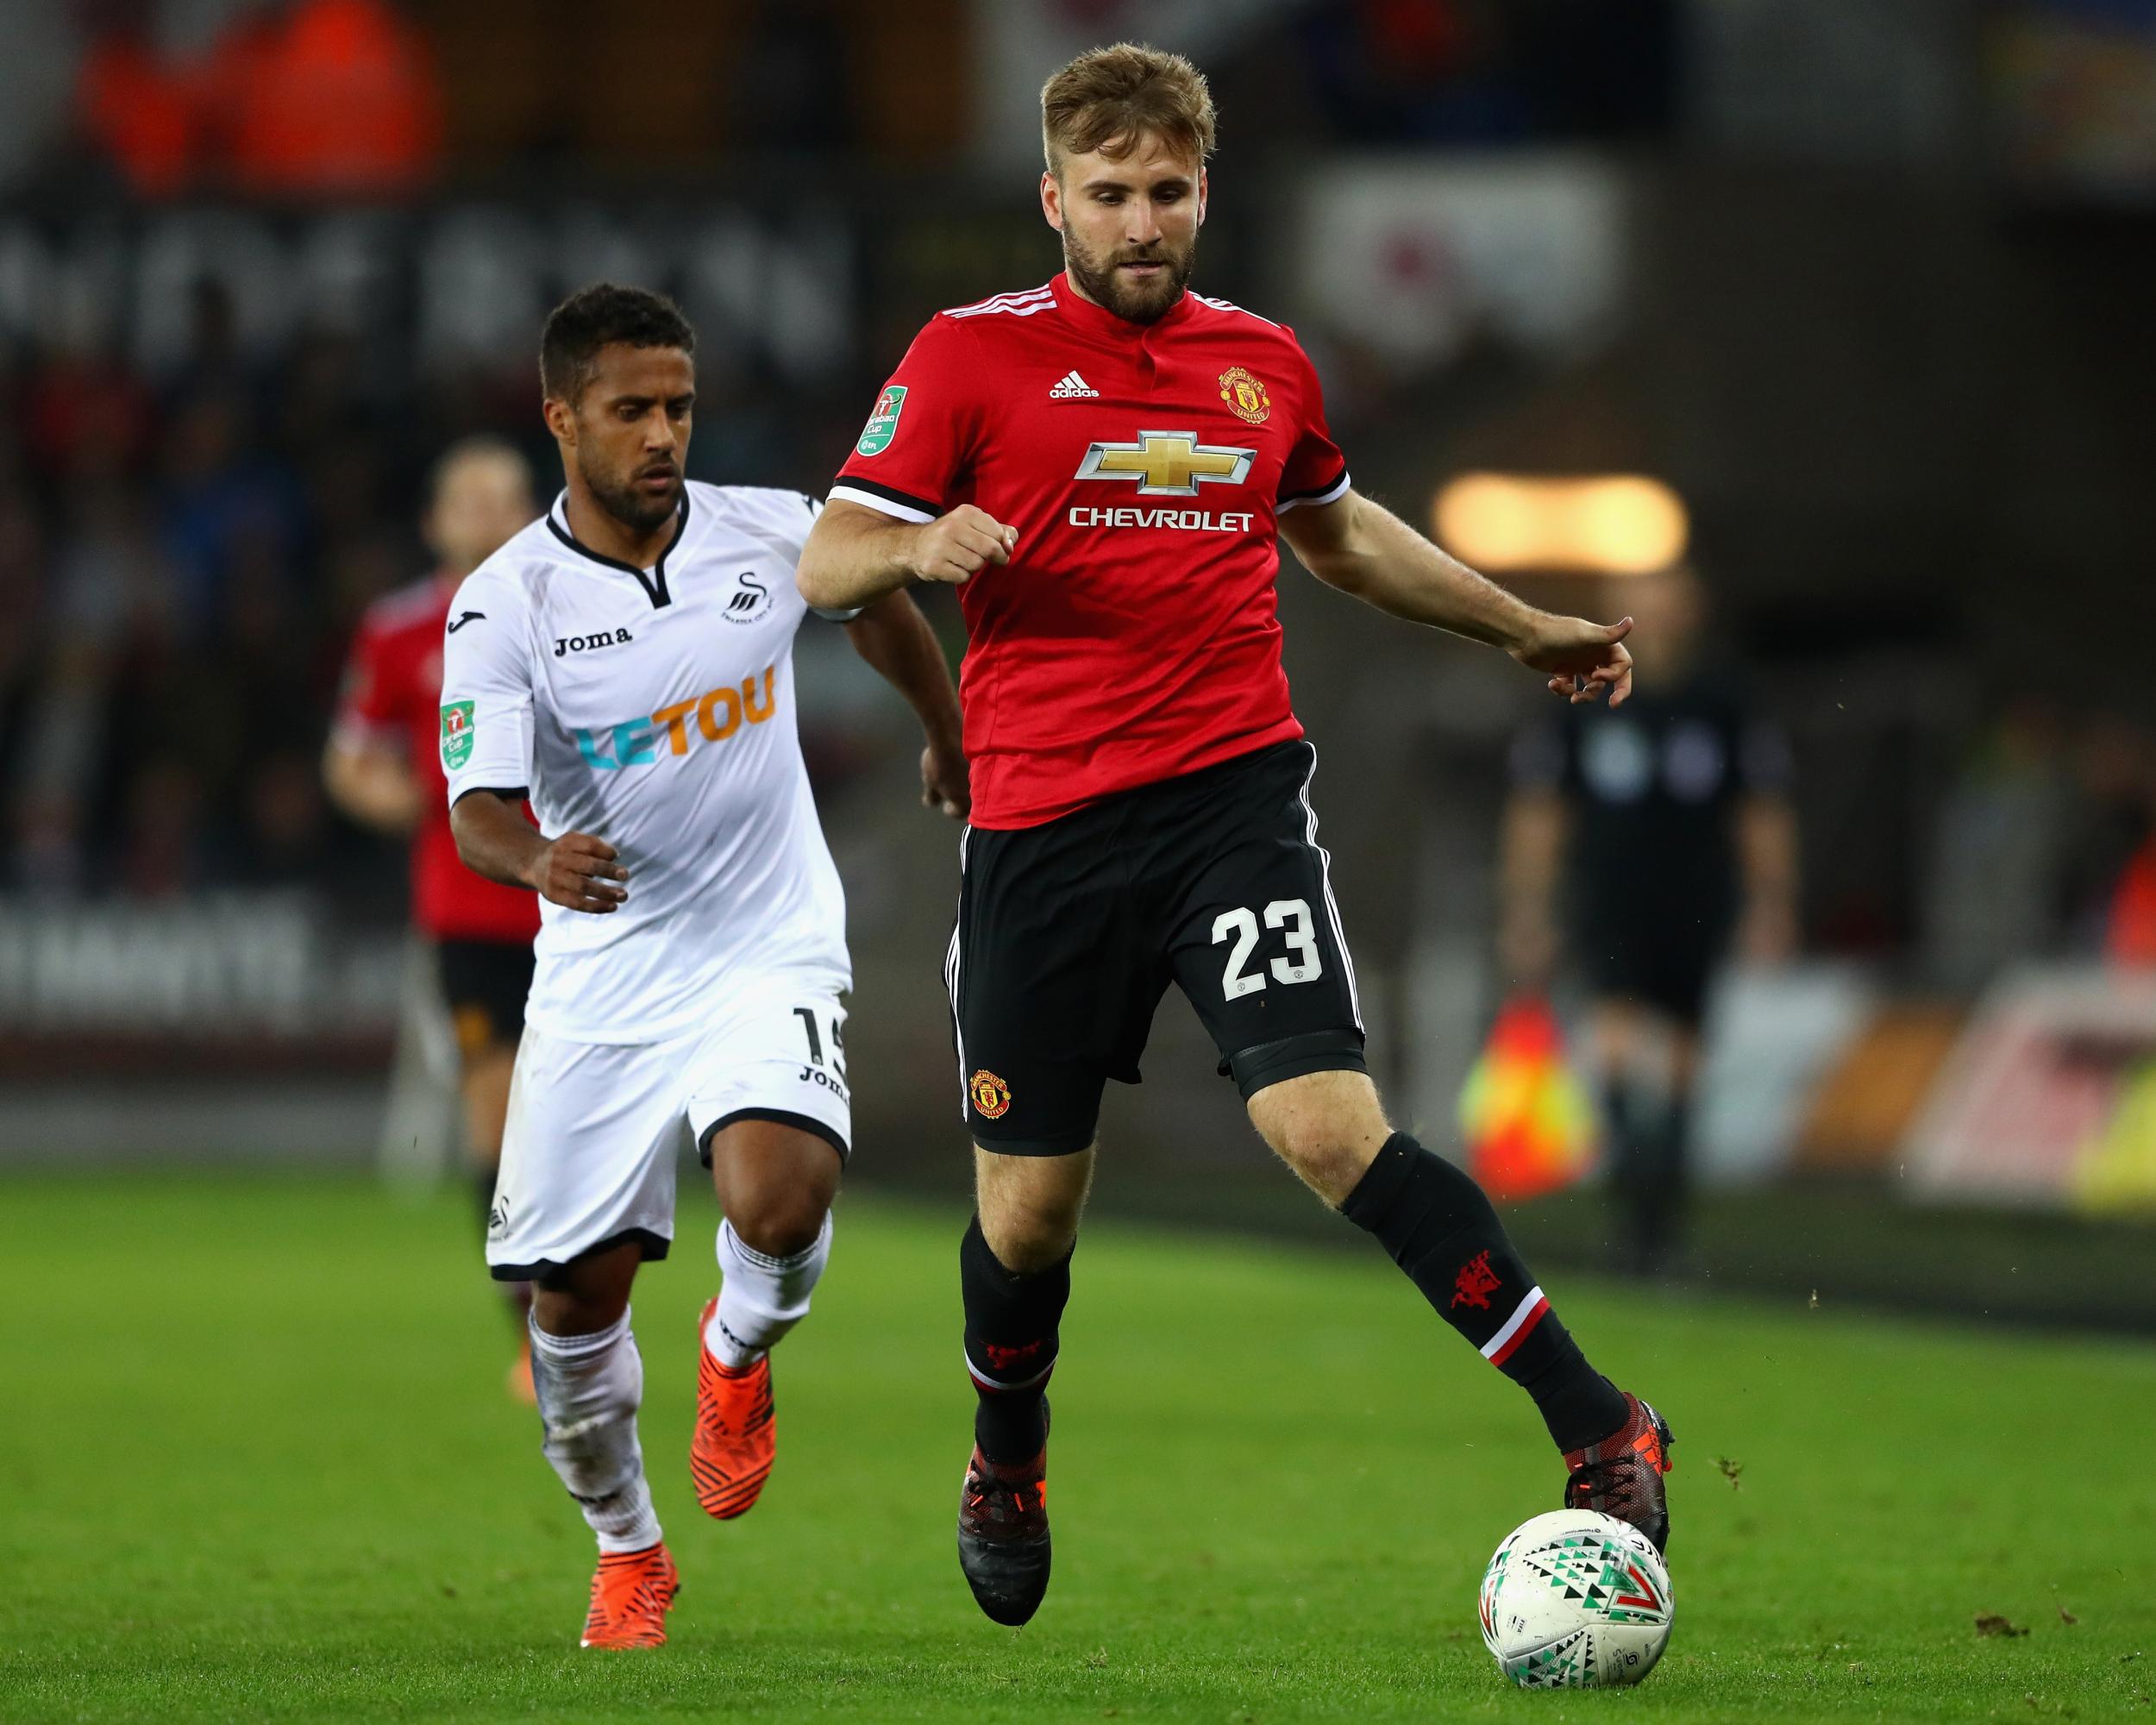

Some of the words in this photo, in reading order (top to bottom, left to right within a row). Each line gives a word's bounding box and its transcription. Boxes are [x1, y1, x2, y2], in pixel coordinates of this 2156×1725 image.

[1049, 387, 1100, 398] adidas
[1237, 408, 1266, 420] UNITED
[868, 425, 882, 434] Cup
[1069, 506, 1255, 532] CHEVROLET
[555, 628, 634, 657] Joma
[575, 662, 776, 770] LETOU
[1211, 898, 1323, 1002] 23
[799, 1065, 849, 1106] Jom
[981, 1107, 1004, 1115] UNITED
